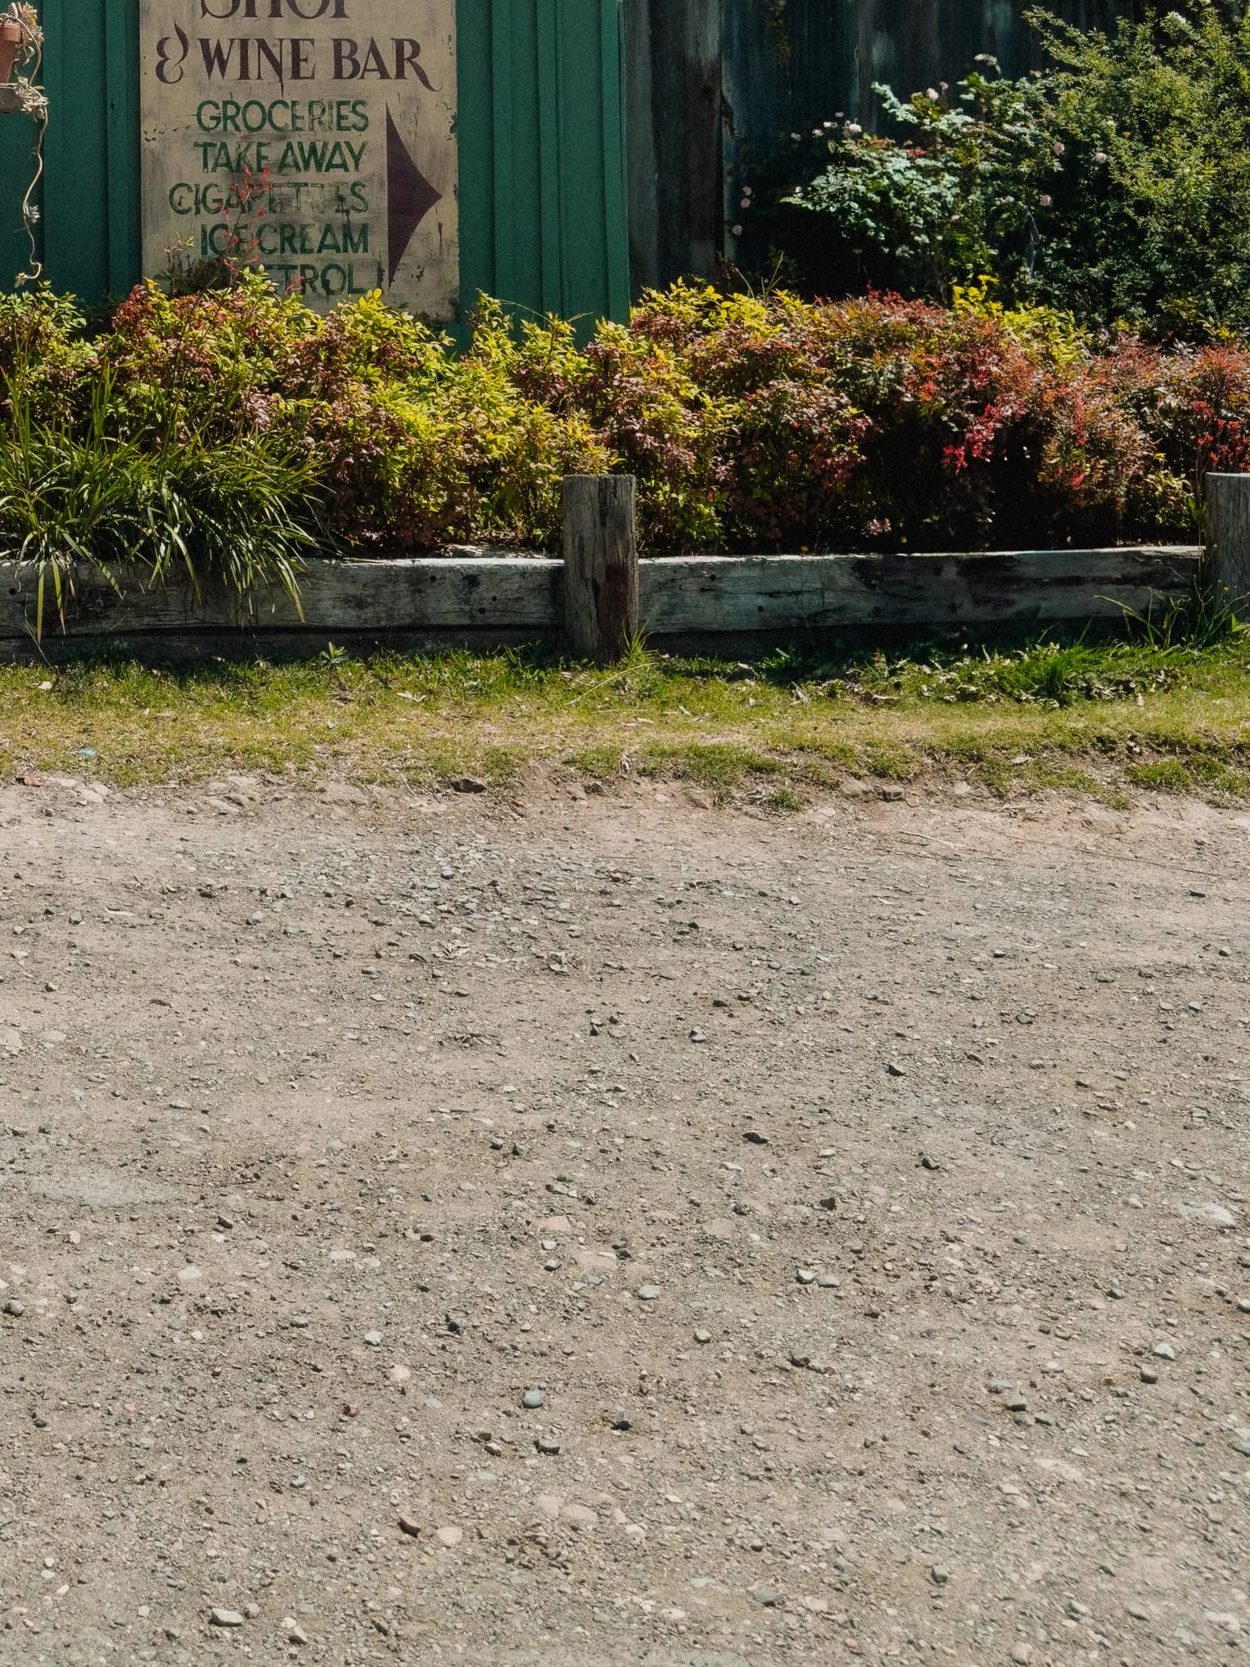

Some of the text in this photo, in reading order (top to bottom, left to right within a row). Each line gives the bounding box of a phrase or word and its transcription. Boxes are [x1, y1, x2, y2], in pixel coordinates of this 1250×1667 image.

[155, 19, 444, 96] & WINE BAR
[195, 99, 370, 133] GROCERIES
[193, 141, 368, 174] TAKE AWAY
[255, 223, 370, 255] CREAM
[247, 262, 368, 297] TROL
